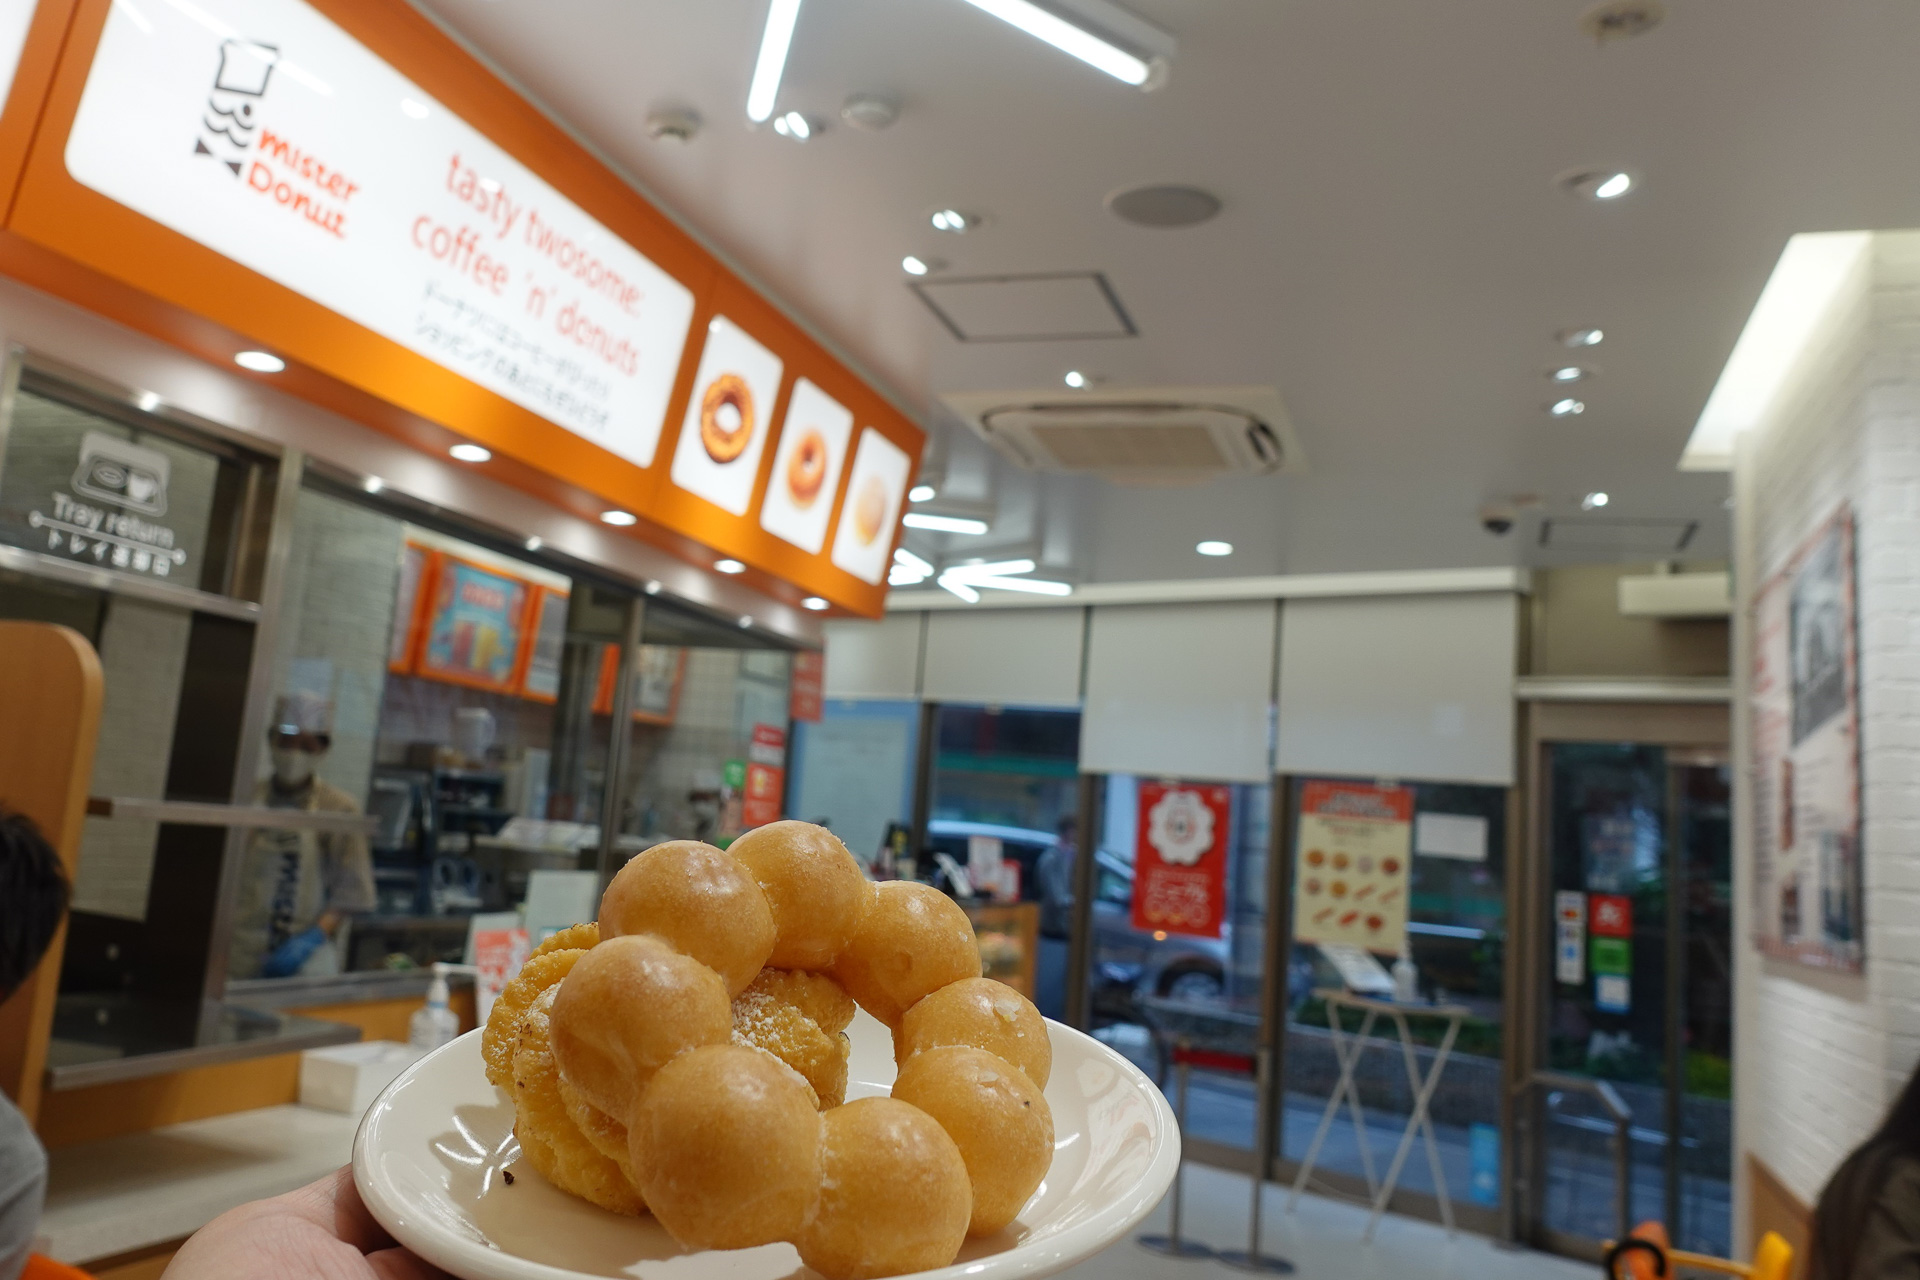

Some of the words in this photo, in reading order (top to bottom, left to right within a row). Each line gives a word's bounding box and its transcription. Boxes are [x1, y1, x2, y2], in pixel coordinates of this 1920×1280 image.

[248, 161, 345, 239] Donut
[446, 153, 522, 240] tasty
[411, 214, 510, 296] coffee
[555, 299, 639, 378] donuts
[52, 491, 105, 534] Tray
[105, 512, 175, 550] return
